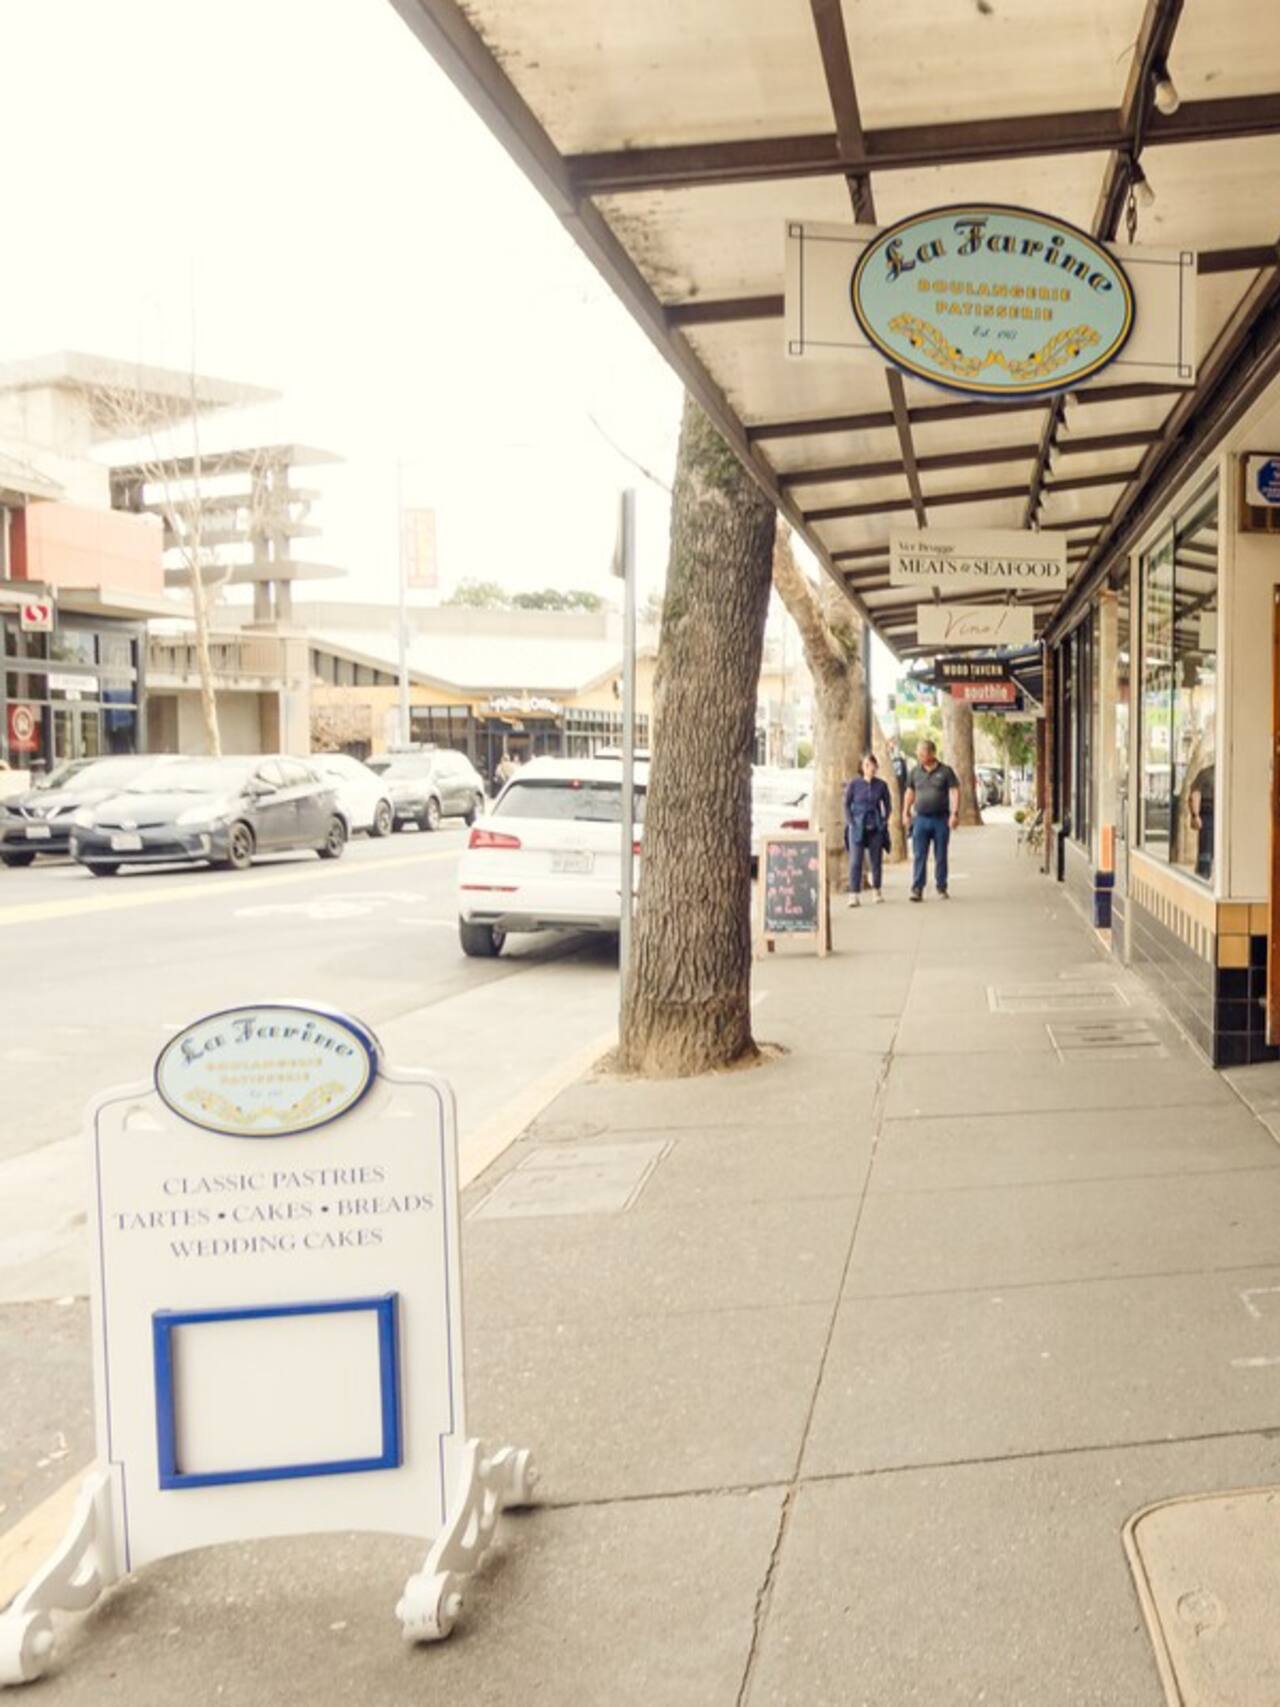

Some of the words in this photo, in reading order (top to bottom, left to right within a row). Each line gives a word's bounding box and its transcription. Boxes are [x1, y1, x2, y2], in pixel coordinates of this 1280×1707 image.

[885, 235, 947, 283] La
[953, 216, 1113, 293] Farine
[917, 278, 1072, 302] BOULANGERIE
[935, 301, 1055, 322] PATISSERIE
[898, 558, 957, 574] MEATS
[974, 561, 1061, 577] SEAFOOD
[180, 1035, 226, 1066] La
[232, 1016, 354, 1057] Farine
[162, 1175, 266, 1196] CLASSIC
[272, 1165, 386, 1189] PASTRIES
[114, 1210, 211, 1231] TARTES
[232, 1202, 314, 1223] CAKES
[337, 1194, 434, 1216] BREADS
[170, 1233, 297, 1259] WEDDING
[304, 1227, 384, 1250] CAKES
